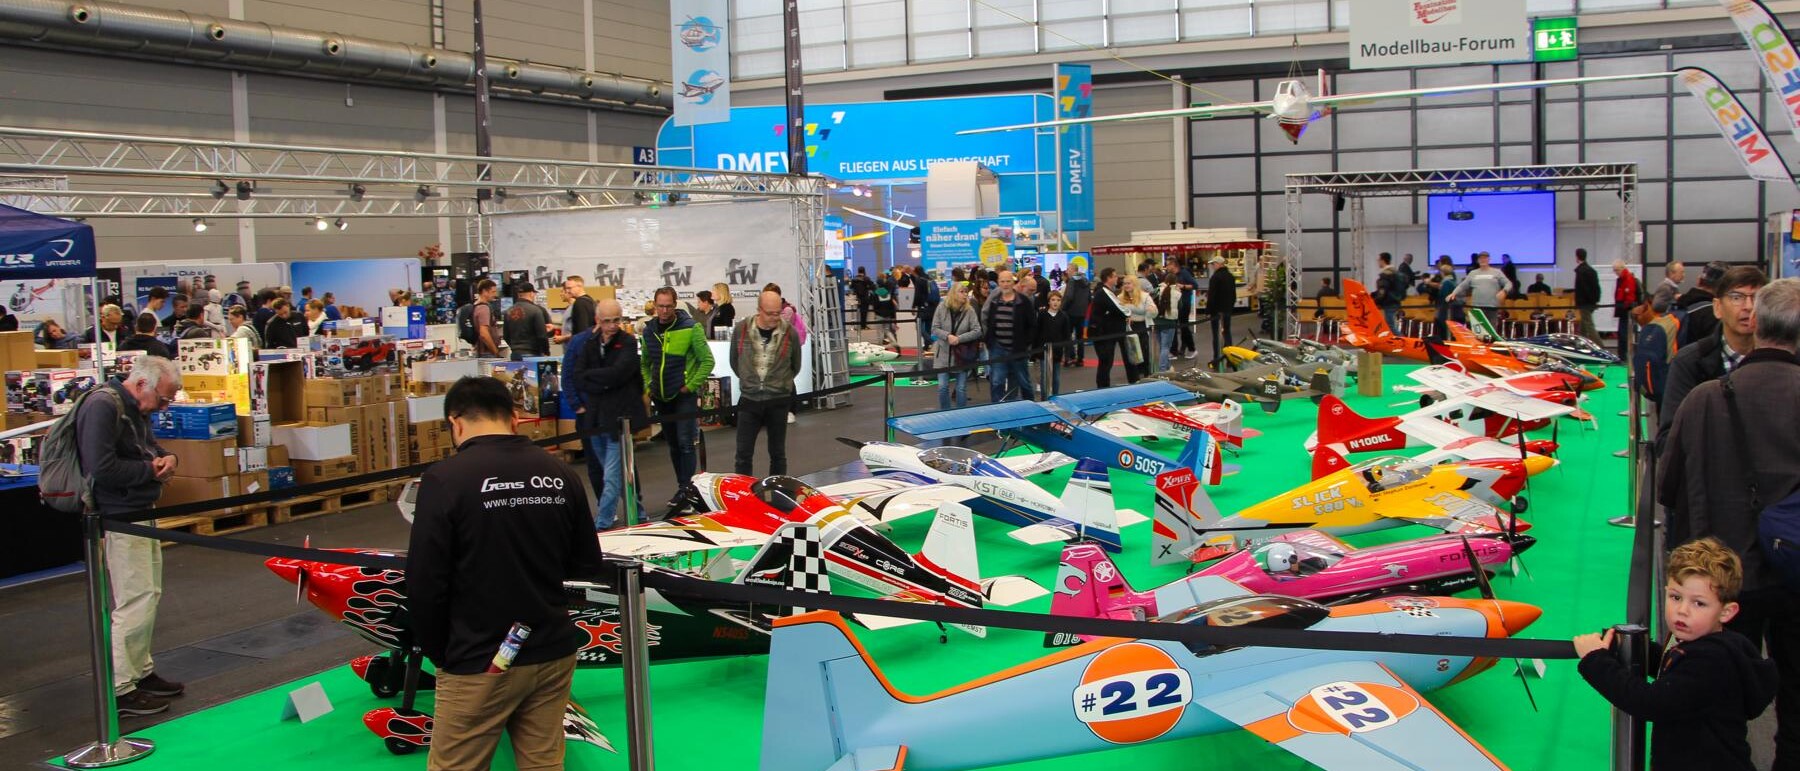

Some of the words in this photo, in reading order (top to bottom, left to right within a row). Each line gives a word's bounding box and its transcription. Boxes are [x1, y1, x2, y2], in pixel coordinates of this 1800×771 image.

[1360, 36, 1516, 57] Modellbau-Forum
[639, 149, 654, 162] A3
[839, 160, 889, 174] FLIEGEN
[893, 158, 917, 172] AUS
[1069, 149, 1082, 195] DMFV
[926, 234, 952, 242] näher
[1350, 434, 1392, 448] N100KL
[481, 477, 525, 493] Gens
[530, 476, 564, 490] ace
[973, 480, 999, 495] KST
[483, 495, 566, 509] www.gensace.de
[1292, 487, 1343, 509] SLICK
[939, 513, 968, 528] FORTIS
[1082, 672, 1182, 716] #22
[1322, 684, 1391, 729] #22
